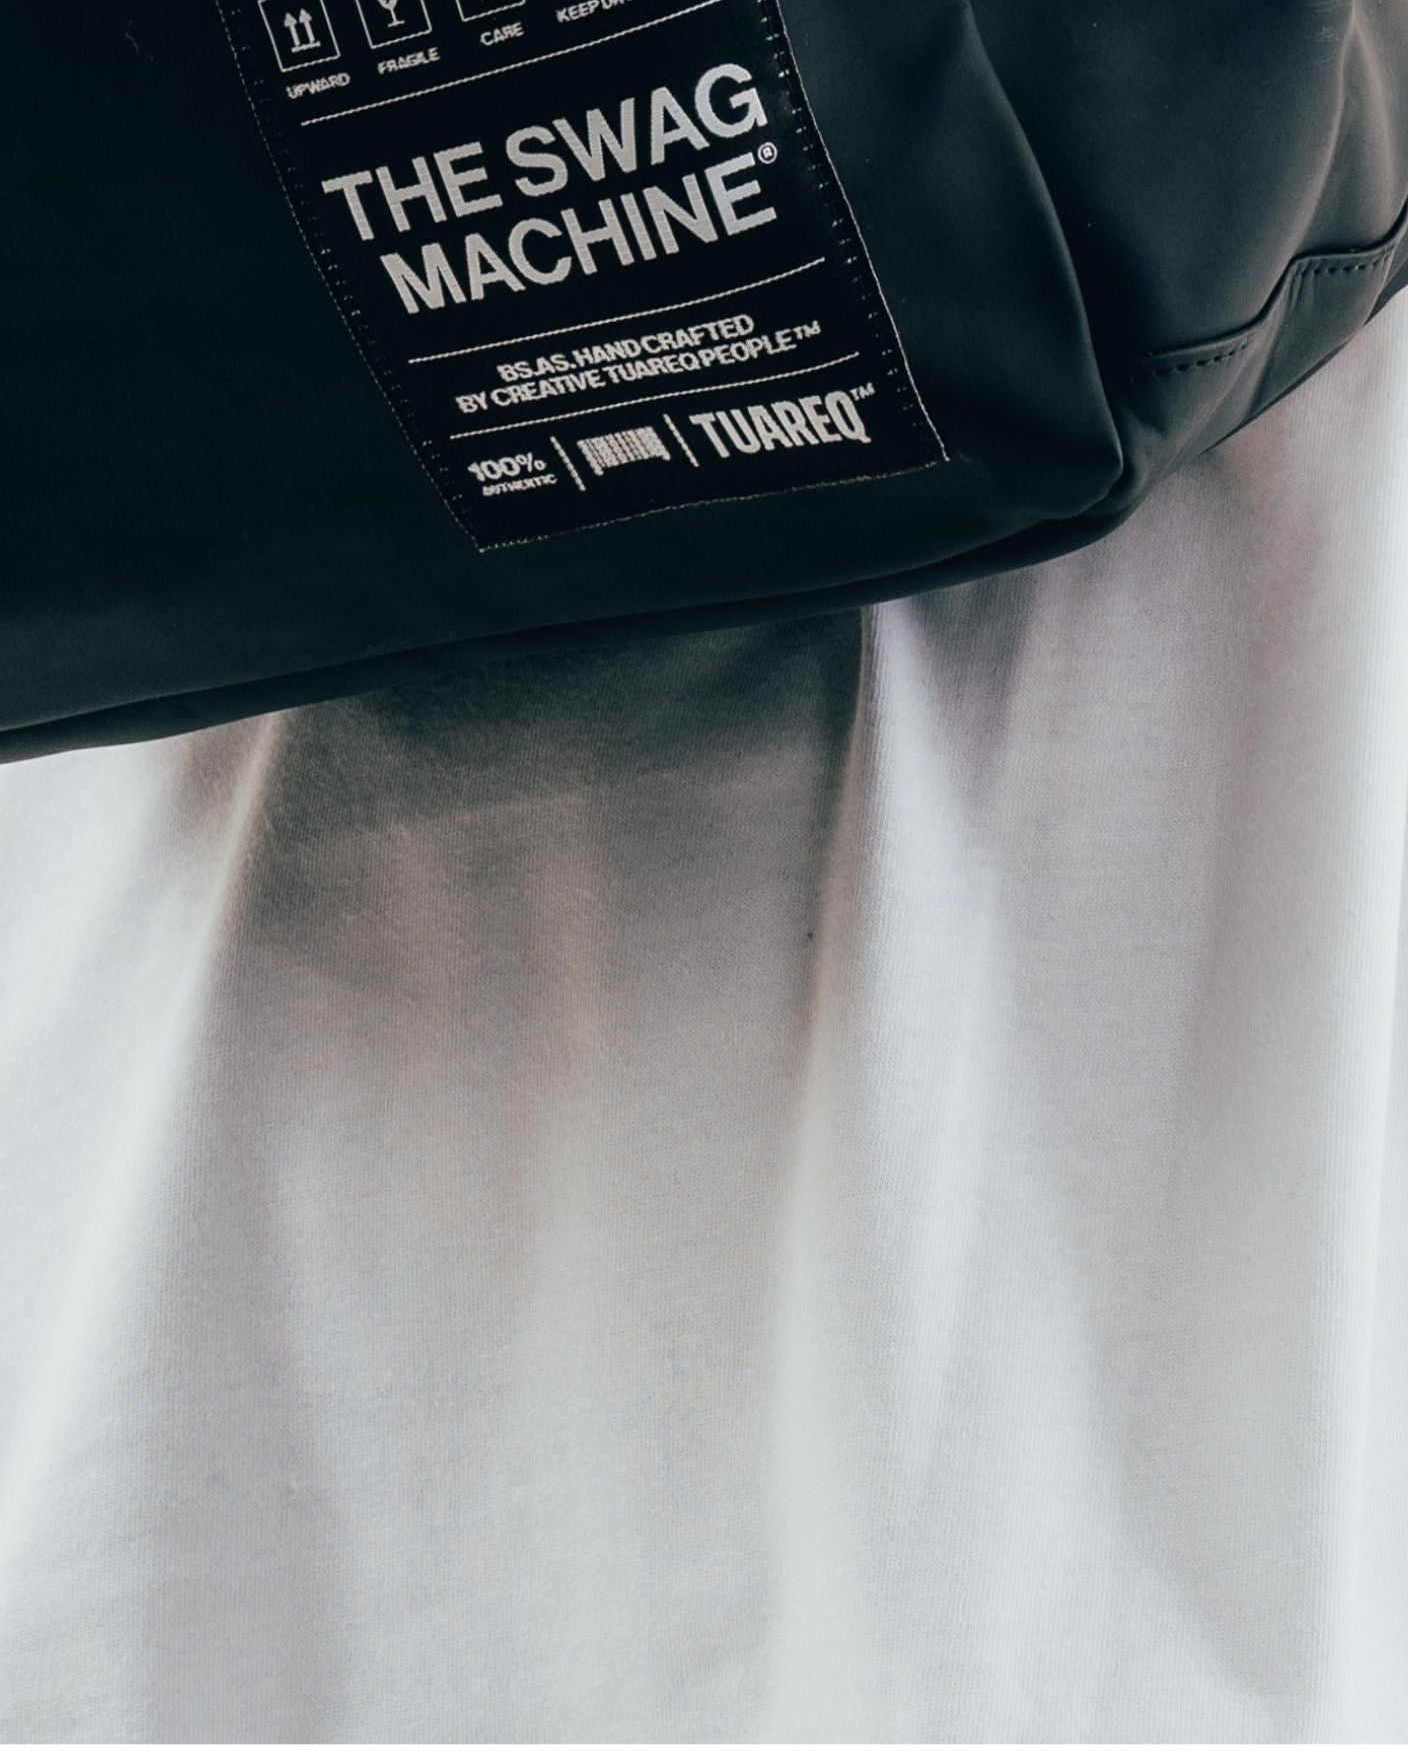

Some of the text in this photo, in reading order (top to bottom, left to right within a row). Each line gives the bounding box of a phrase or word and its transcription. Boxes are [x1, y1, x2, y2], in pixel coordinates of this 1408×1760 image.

[480, 22, 525, 47] CARE
[377, 47, 441, 75] FRAGILE
[286, 72, 351, 99] UPWARD
[322, 63, 769, 241] THE SWAG
[455, 390, 489, 414] BY
[490, 368, 606, 407] CREATIVE
[602, 351, 702, 386] TUAREQ
[467, 452, 547, 483] 100%
